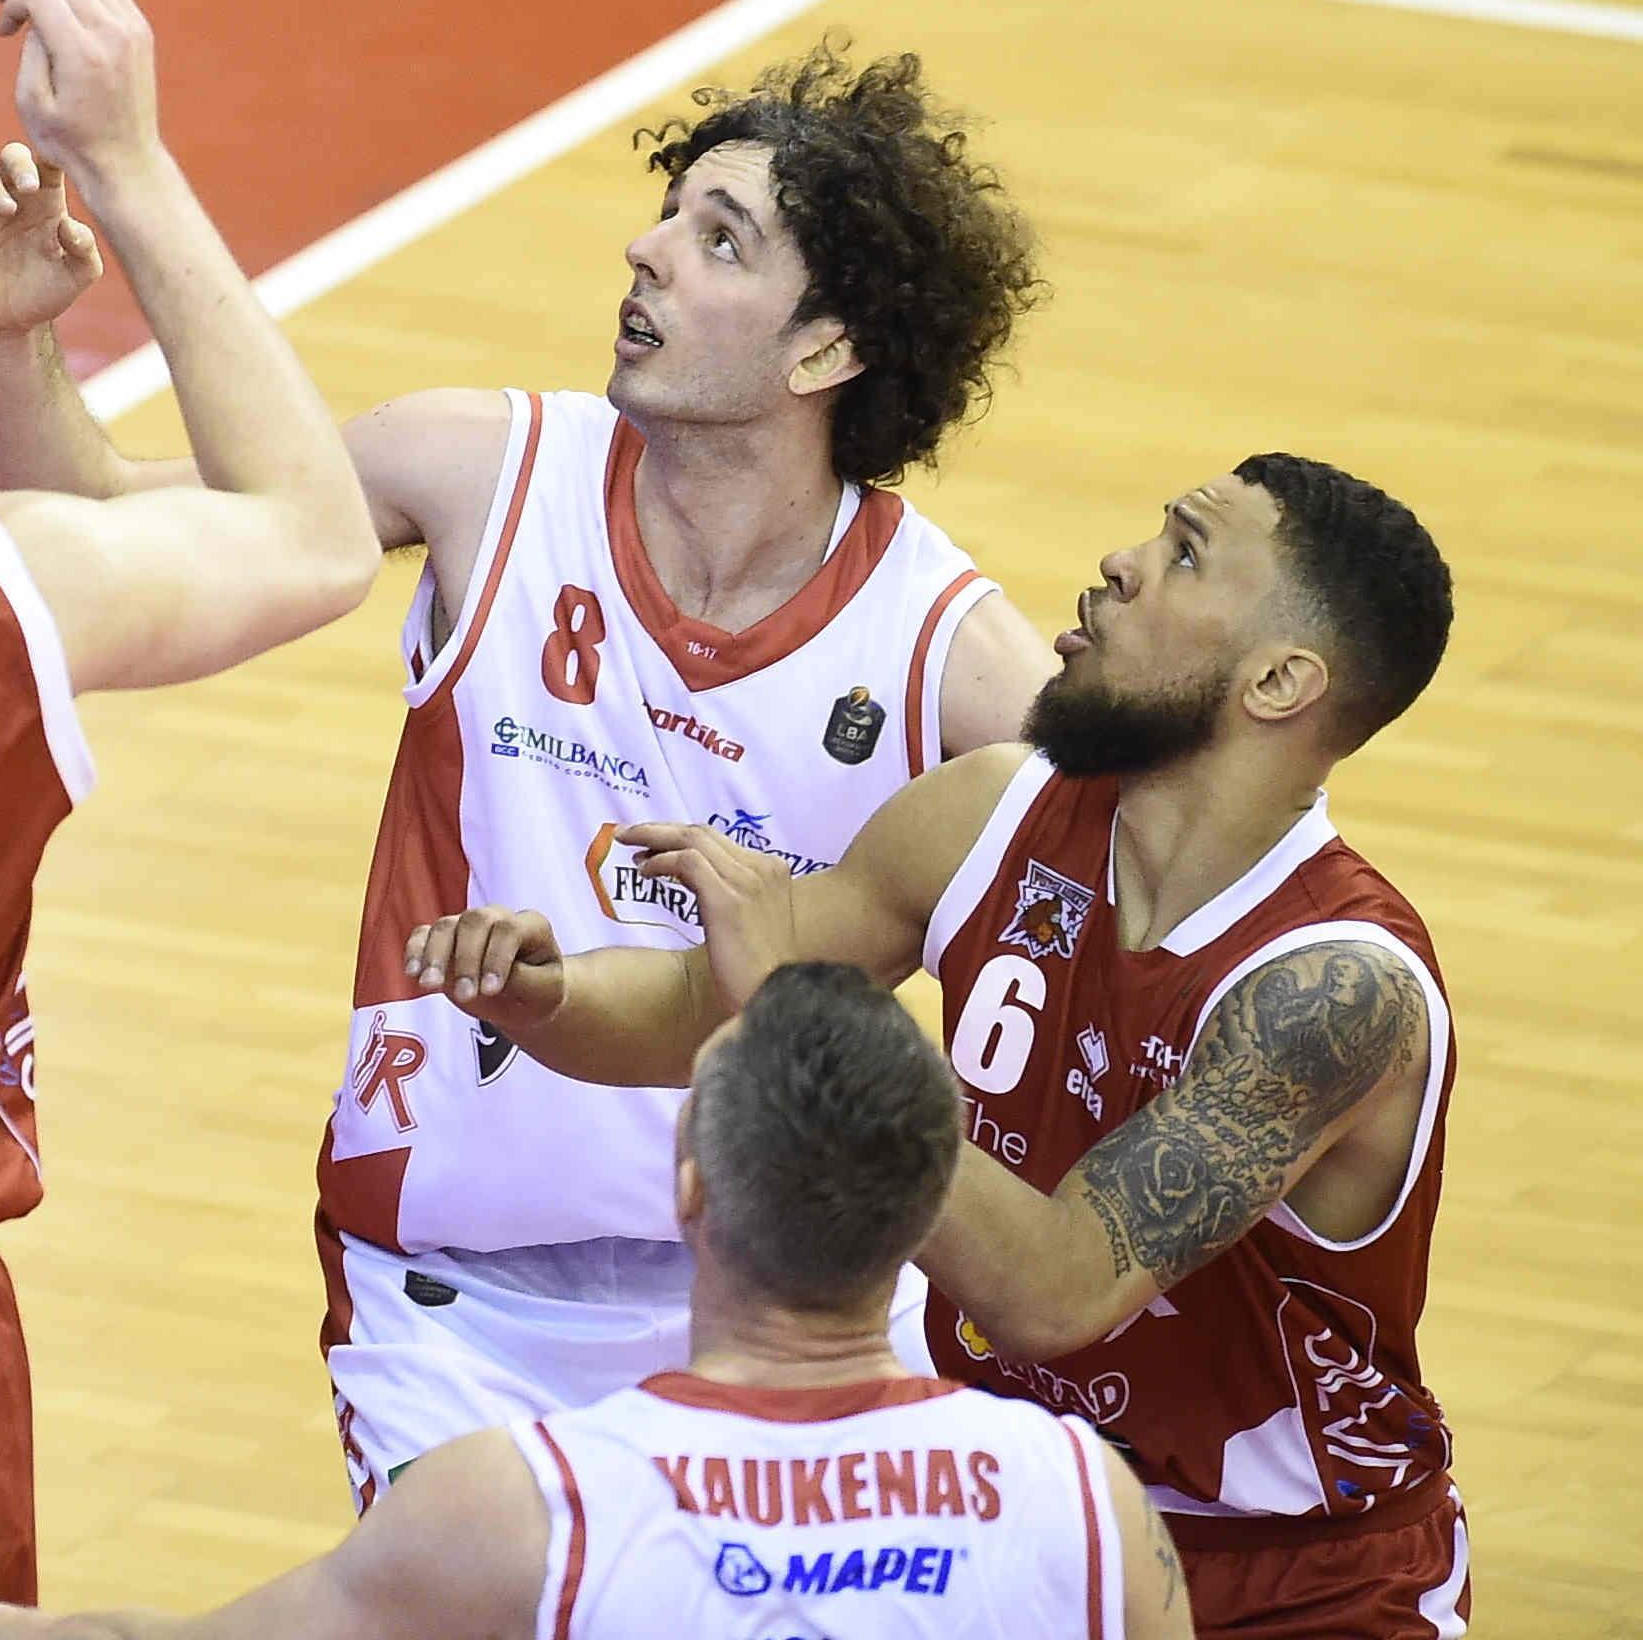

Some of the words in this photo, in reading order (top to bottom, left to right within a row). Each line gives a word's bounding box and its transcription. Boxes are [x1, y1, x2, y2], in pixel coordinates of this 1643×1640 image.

[540, 583, 607, 706] 8
[686, 640, 718, 660] 16-17
[836, 723, 868, 742] LBA
[950, 953, 1047, 1096] 6
[783, 1547, 953, 1596] MAPEI
